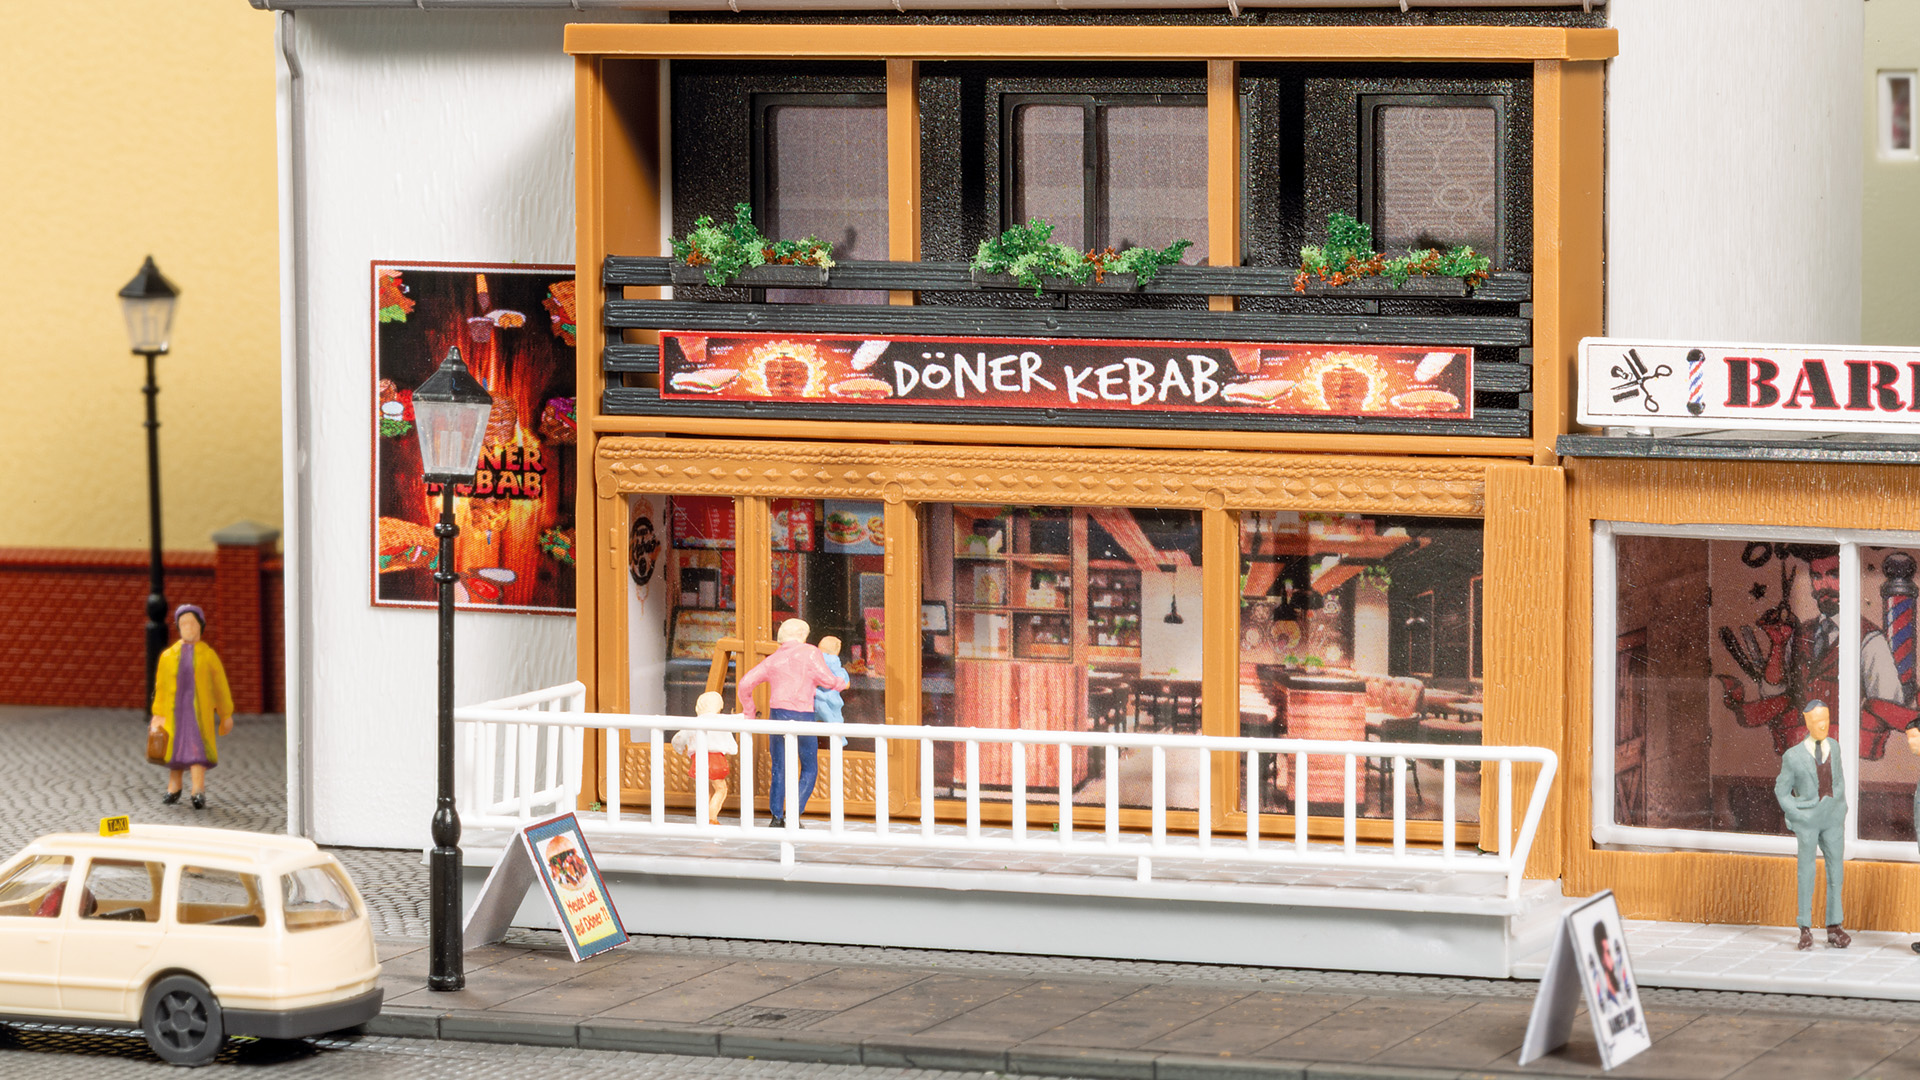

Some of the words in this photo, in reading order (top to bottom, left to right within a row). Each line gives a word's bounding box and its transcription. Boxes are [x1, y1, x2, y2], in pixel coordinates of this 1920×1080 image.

[893, 351, 1057, 398] DÖNER
[1063, 354, 1220, 405] KEBAB
[1723, 357, 1920, 412] BAR
[108, 818, 128, 832] TAXI
[565, 897, 586, 915] Heute
[582, 887, 598, 905] Lust
[574, 918, 586, 937] auf
[582, 912, 603, 931] Döner
